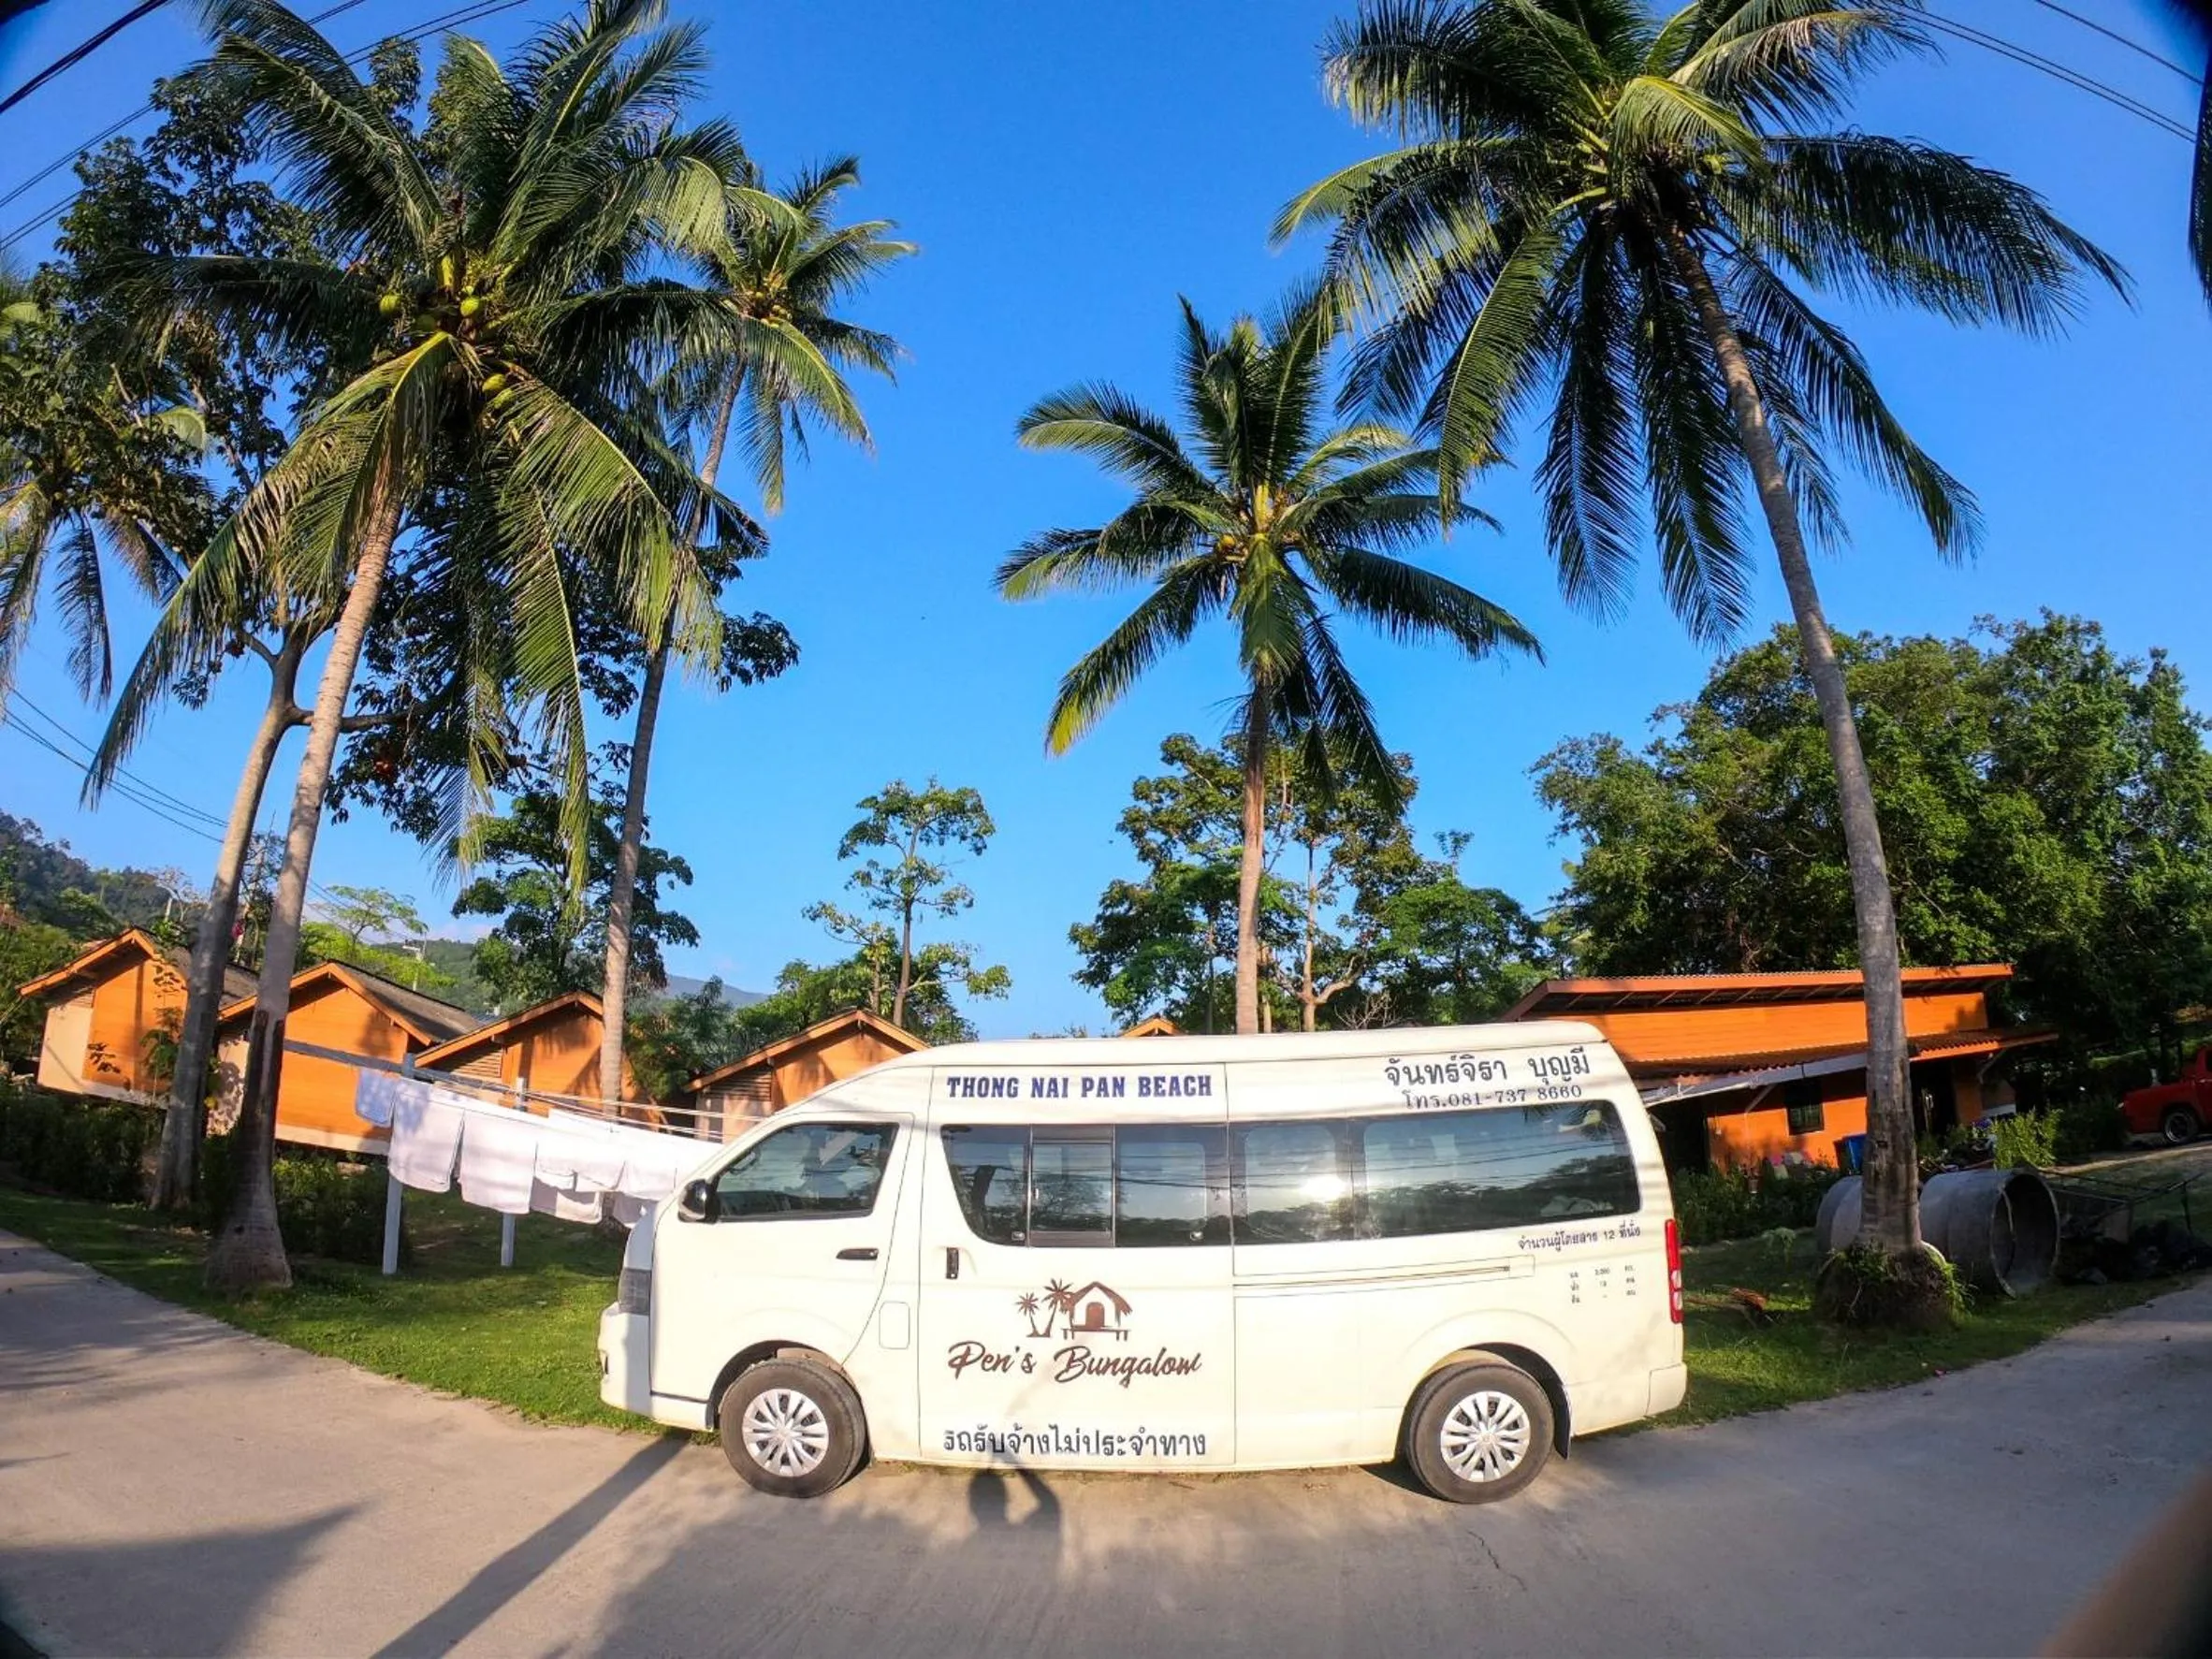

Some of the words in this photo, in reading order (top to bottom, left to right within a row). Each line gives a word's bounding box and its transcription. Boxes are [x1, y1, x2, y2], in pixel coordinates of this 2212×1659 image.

[1384, 1054, 1507, 1086] จันทร์จิรา
[1527, 1046, 1590, 1085] บุญมี
[947, 1076, 1019, 1098] THONG
[1030, 1076, 1070, 1099] NAI
[1081, 1076, 1126, 1098] PAN
[1138, 1075, 1212, 1097] BEACH
[1603, 1230, 1615, 1241] 12
[947, 1340, 1037, 1380] Pen's
[1053, 1345, 1202, 1389] Bungalow
[943, 1422, 1206, 1456] รถรับจ้างไม่ประจำทาง
